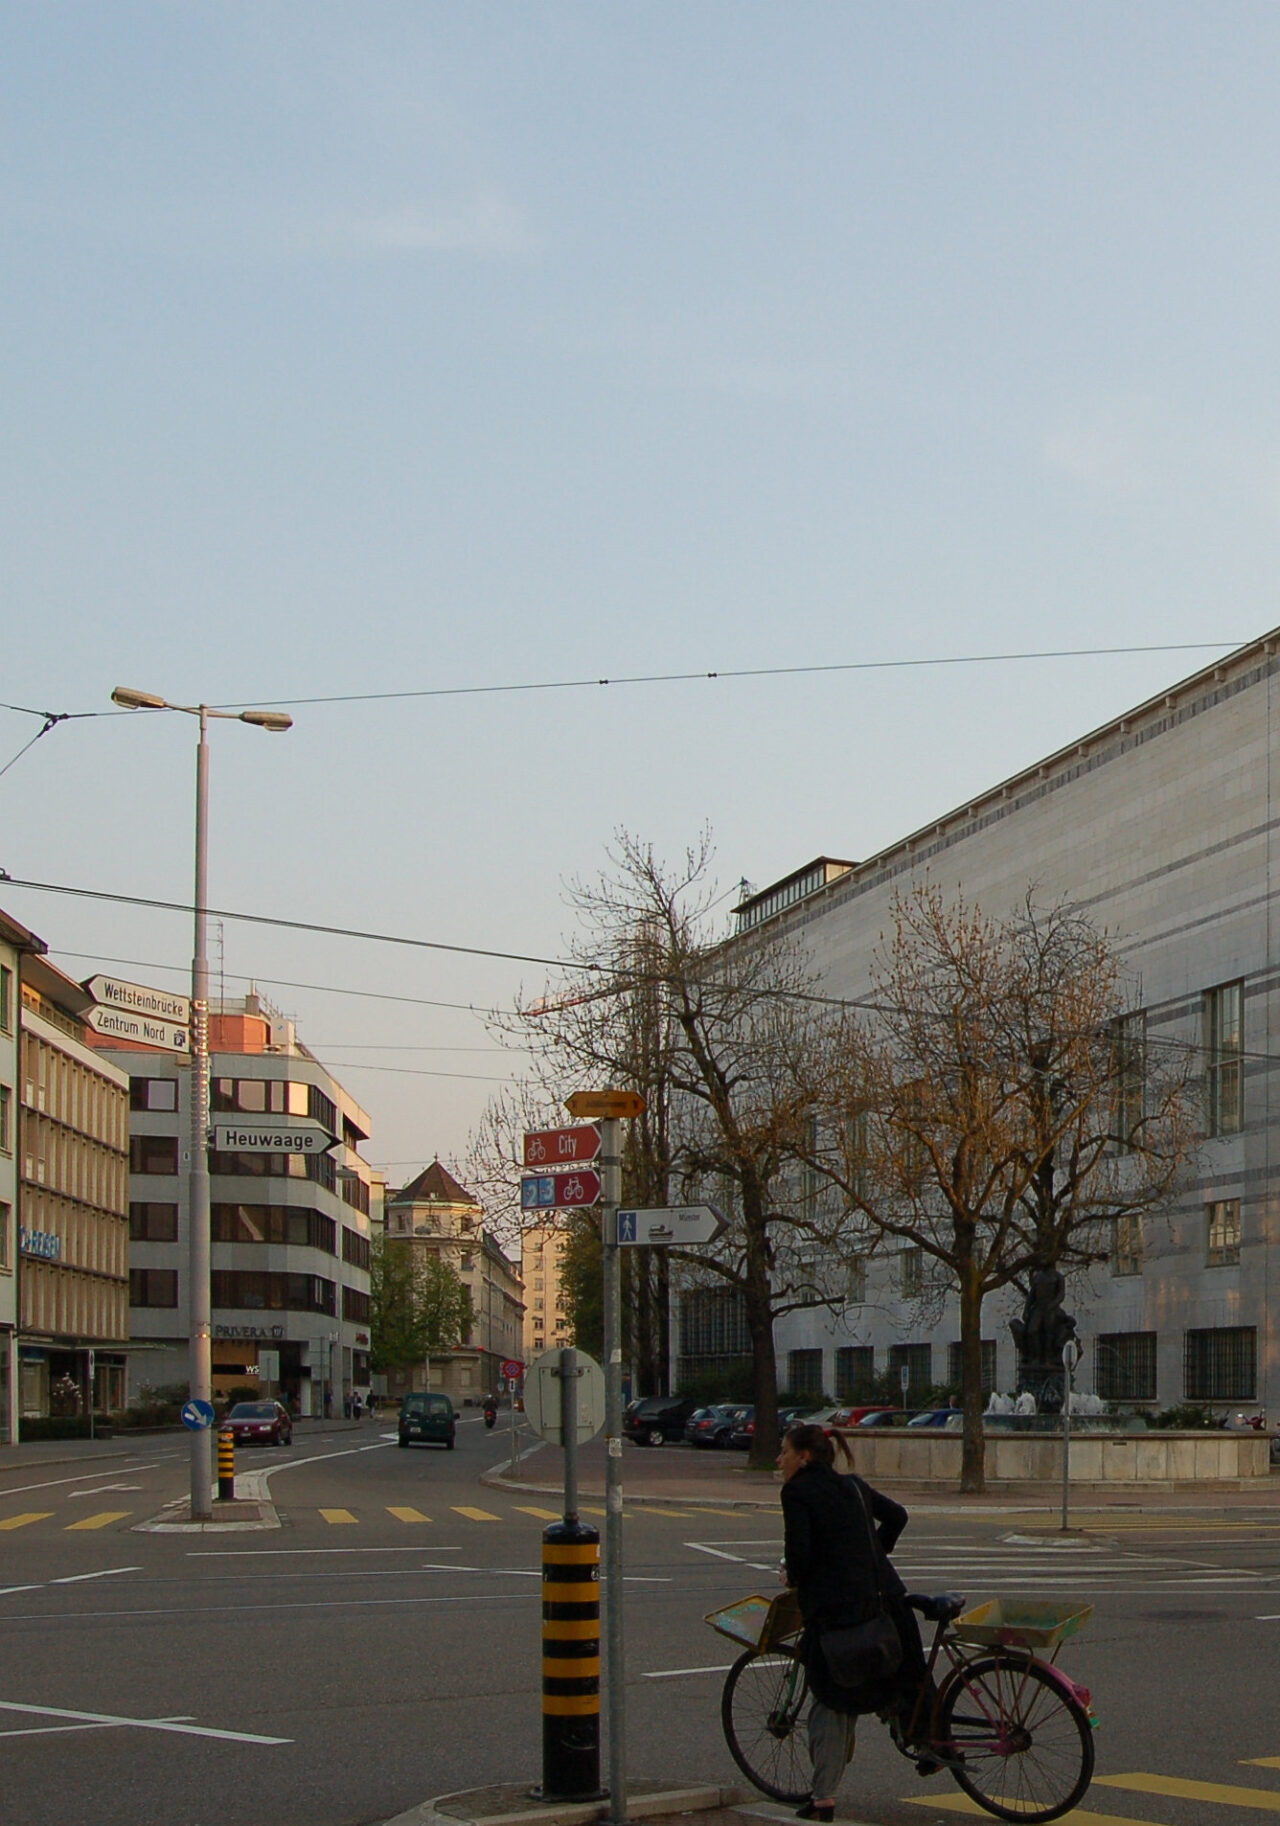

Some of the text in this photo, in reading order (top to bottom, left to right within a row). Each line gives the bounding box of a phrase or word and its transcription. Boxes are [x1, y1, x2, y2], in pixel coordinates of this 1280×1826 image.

[104, 982, 183, 1017] Wettsteinbrücke
[97, 1011, 165, 1041] Zentrum Nord
[225, 1130, 313, 1151] Heuwaage
[558, 1134, 577, 1158] City
[215, 1325, 266, 1337] PRIVERA
